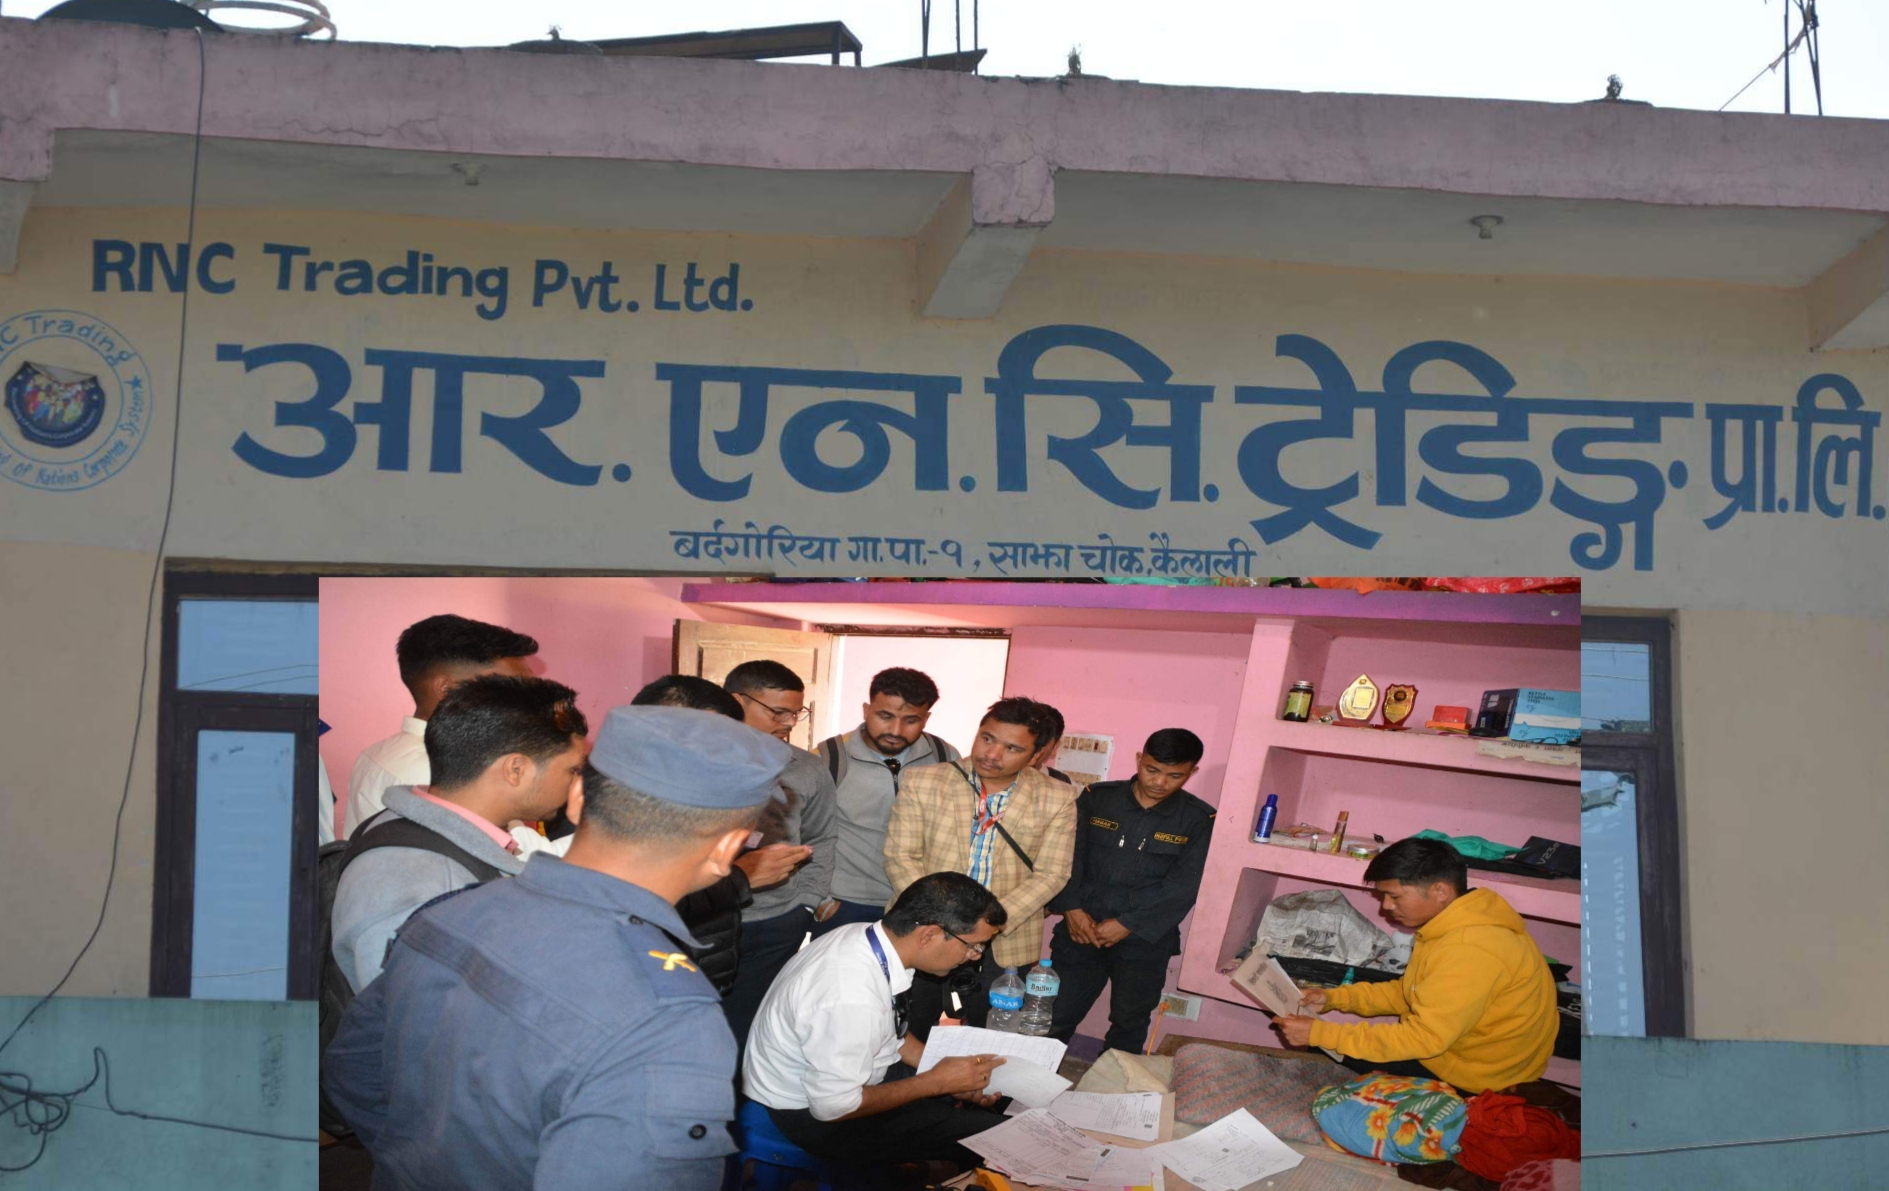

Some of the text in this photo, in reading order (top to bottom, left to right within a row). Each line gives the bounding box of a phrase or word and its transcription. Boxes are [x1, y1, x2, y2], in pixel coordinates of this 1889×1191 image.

[93, 240, 753, 319] RNC Trading Pvt. Ltd.
[24, 314, 137, 367] Trading
